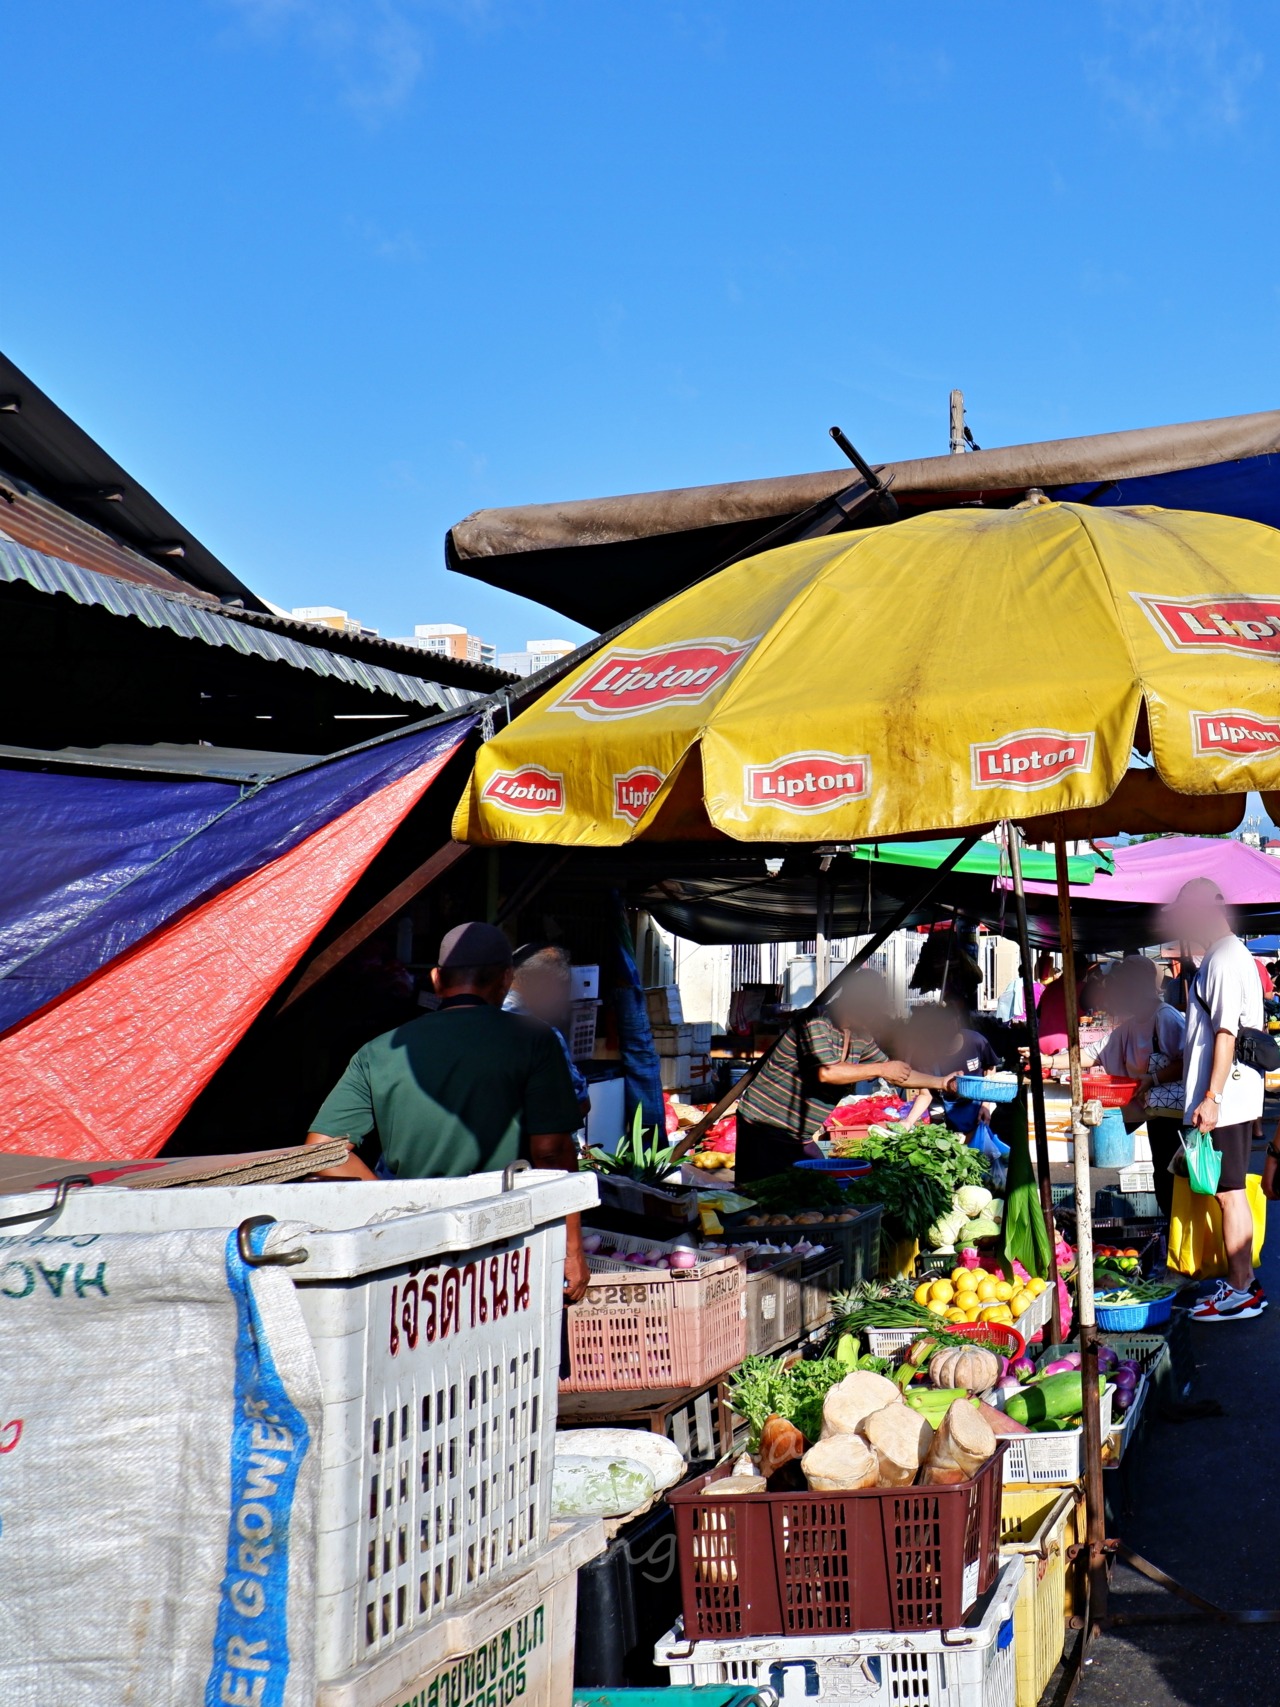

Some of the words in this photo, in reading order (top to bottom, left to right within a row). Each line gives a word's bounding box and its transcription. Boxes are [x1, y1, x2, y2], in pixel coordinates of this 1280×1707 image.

[591, 665, 719, 696] Lipton
[1206, 721, 1280, 745] Lipton
[988, 747, 1080, 775] Lipton
[495, 780, 557, 804] Lipton
[622, 786, 658, 808] Lipto
[762, 772, 856, 799] Lipton
